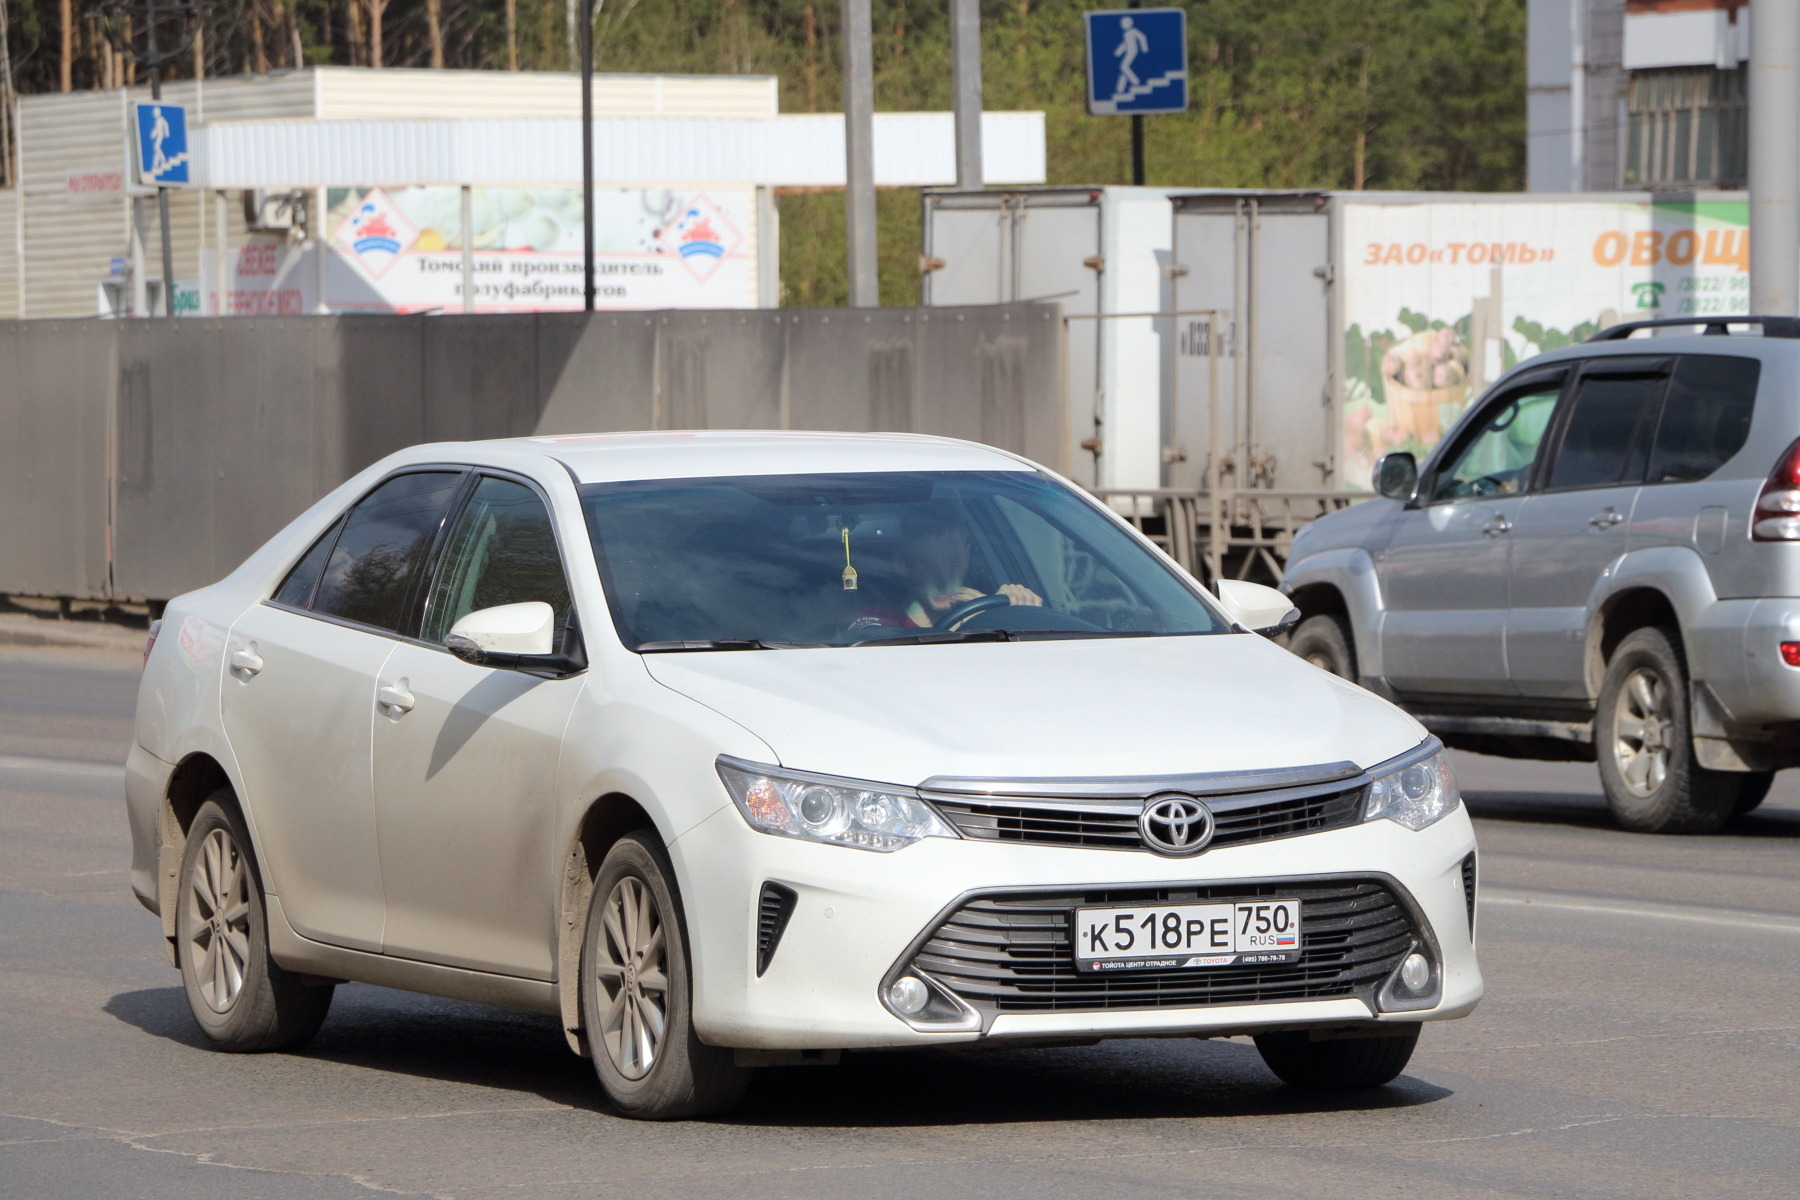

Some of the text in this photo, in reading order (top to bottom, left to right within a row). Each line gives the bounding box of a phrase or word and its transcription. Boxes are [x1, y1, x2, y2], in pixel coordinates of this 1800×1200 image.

[511, 258, 664, 277] произвдитель
[455, 280, 627, 300] полуфабриктов
[1238, 904, 1289, 935] 750
[1250, 934, 1275, 946] RUS
[1102, 959, 1177, 969] ТОЙОТА ЦЕНТР ОТРАДНОЕ
[1242, 955, 1257, 963] (495)
